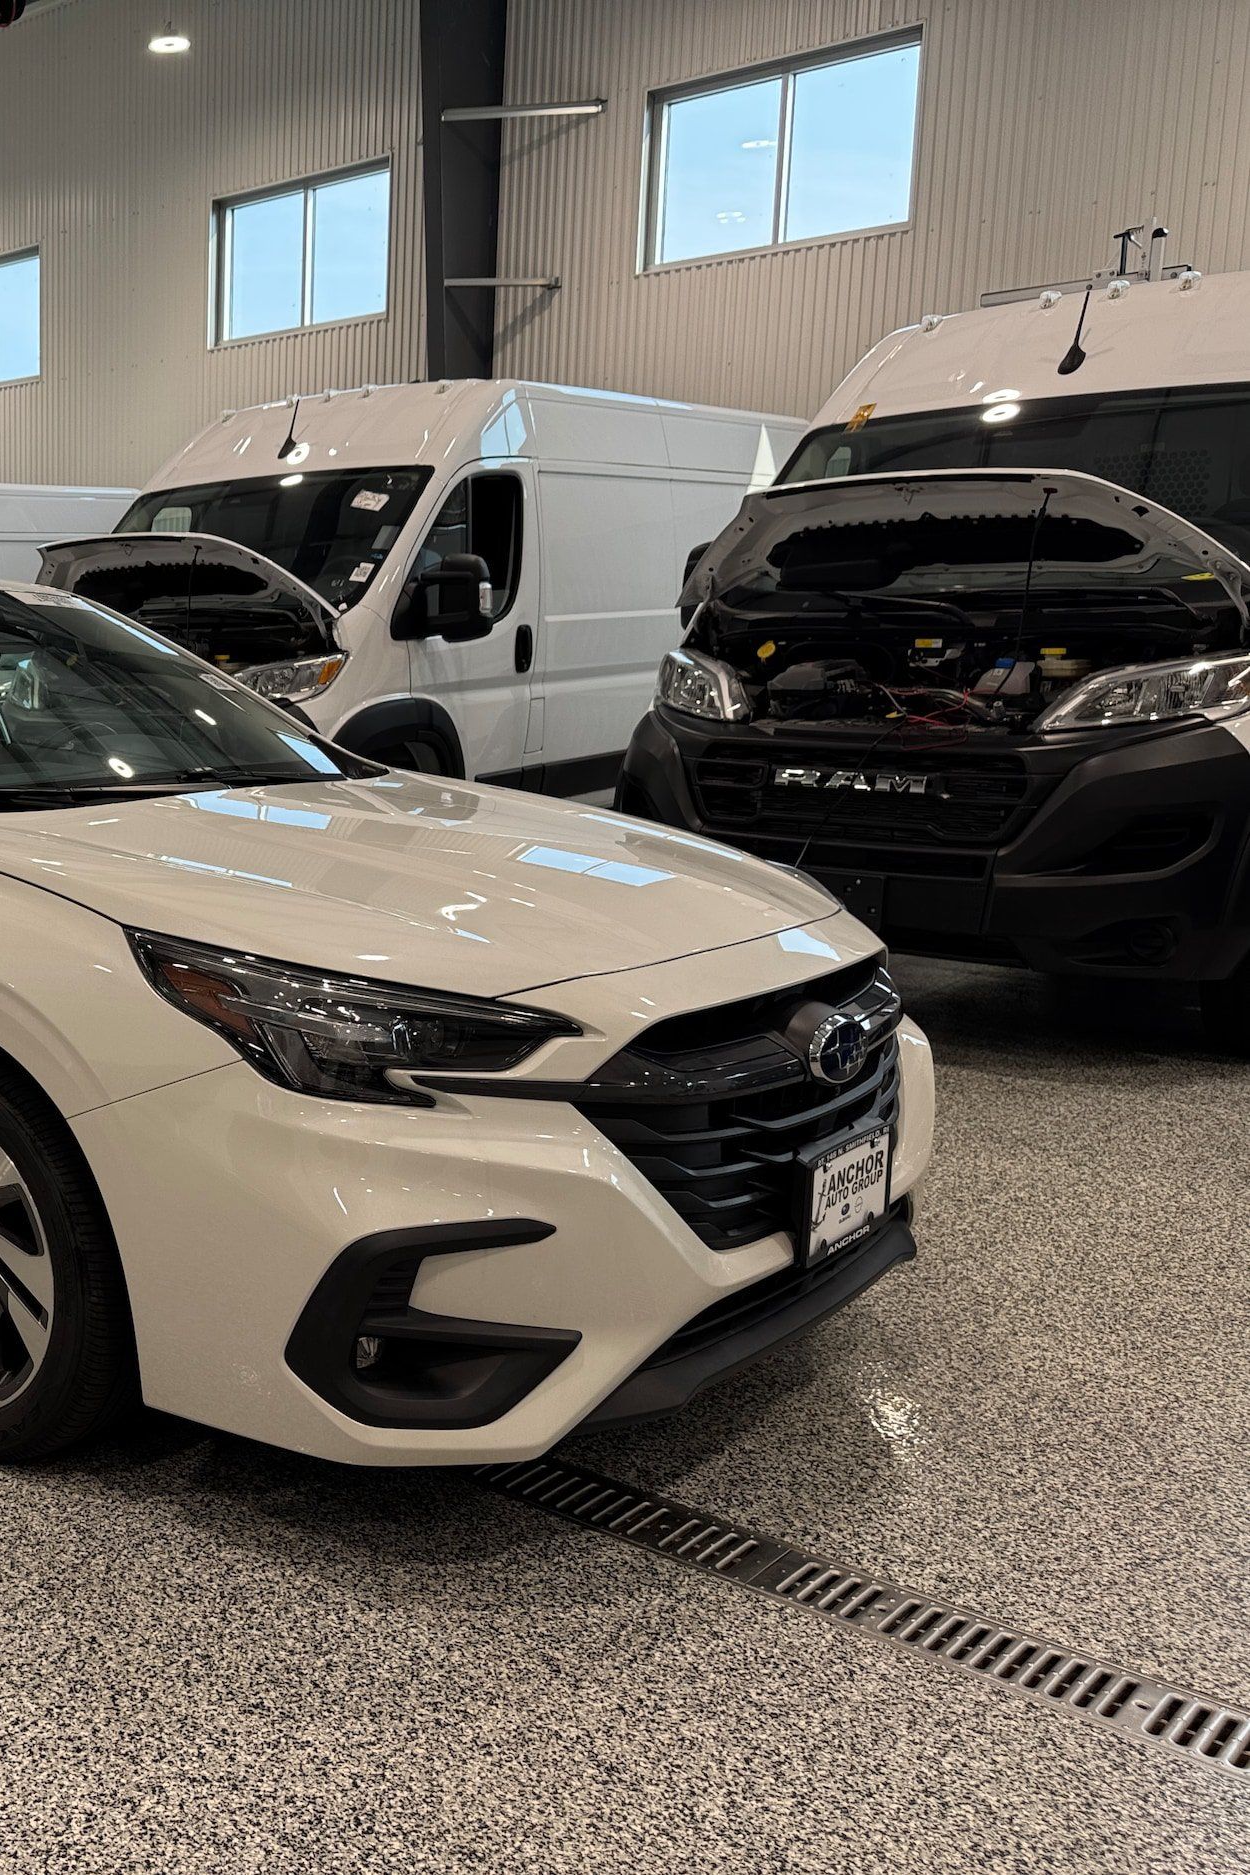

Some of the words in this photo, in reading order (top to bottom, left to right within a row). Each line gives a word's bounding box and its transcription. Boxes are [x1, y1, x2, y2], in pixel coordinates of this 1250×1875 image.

[773, 768, 928, 794] RAM
[824, 1186, 849, 1210] AUTO
[851, 1169, 883, 1195] GROUP
[827, 1150, 884, 1195] ANCHOR
[827, 1225, 870, 1256] ANCHOR
